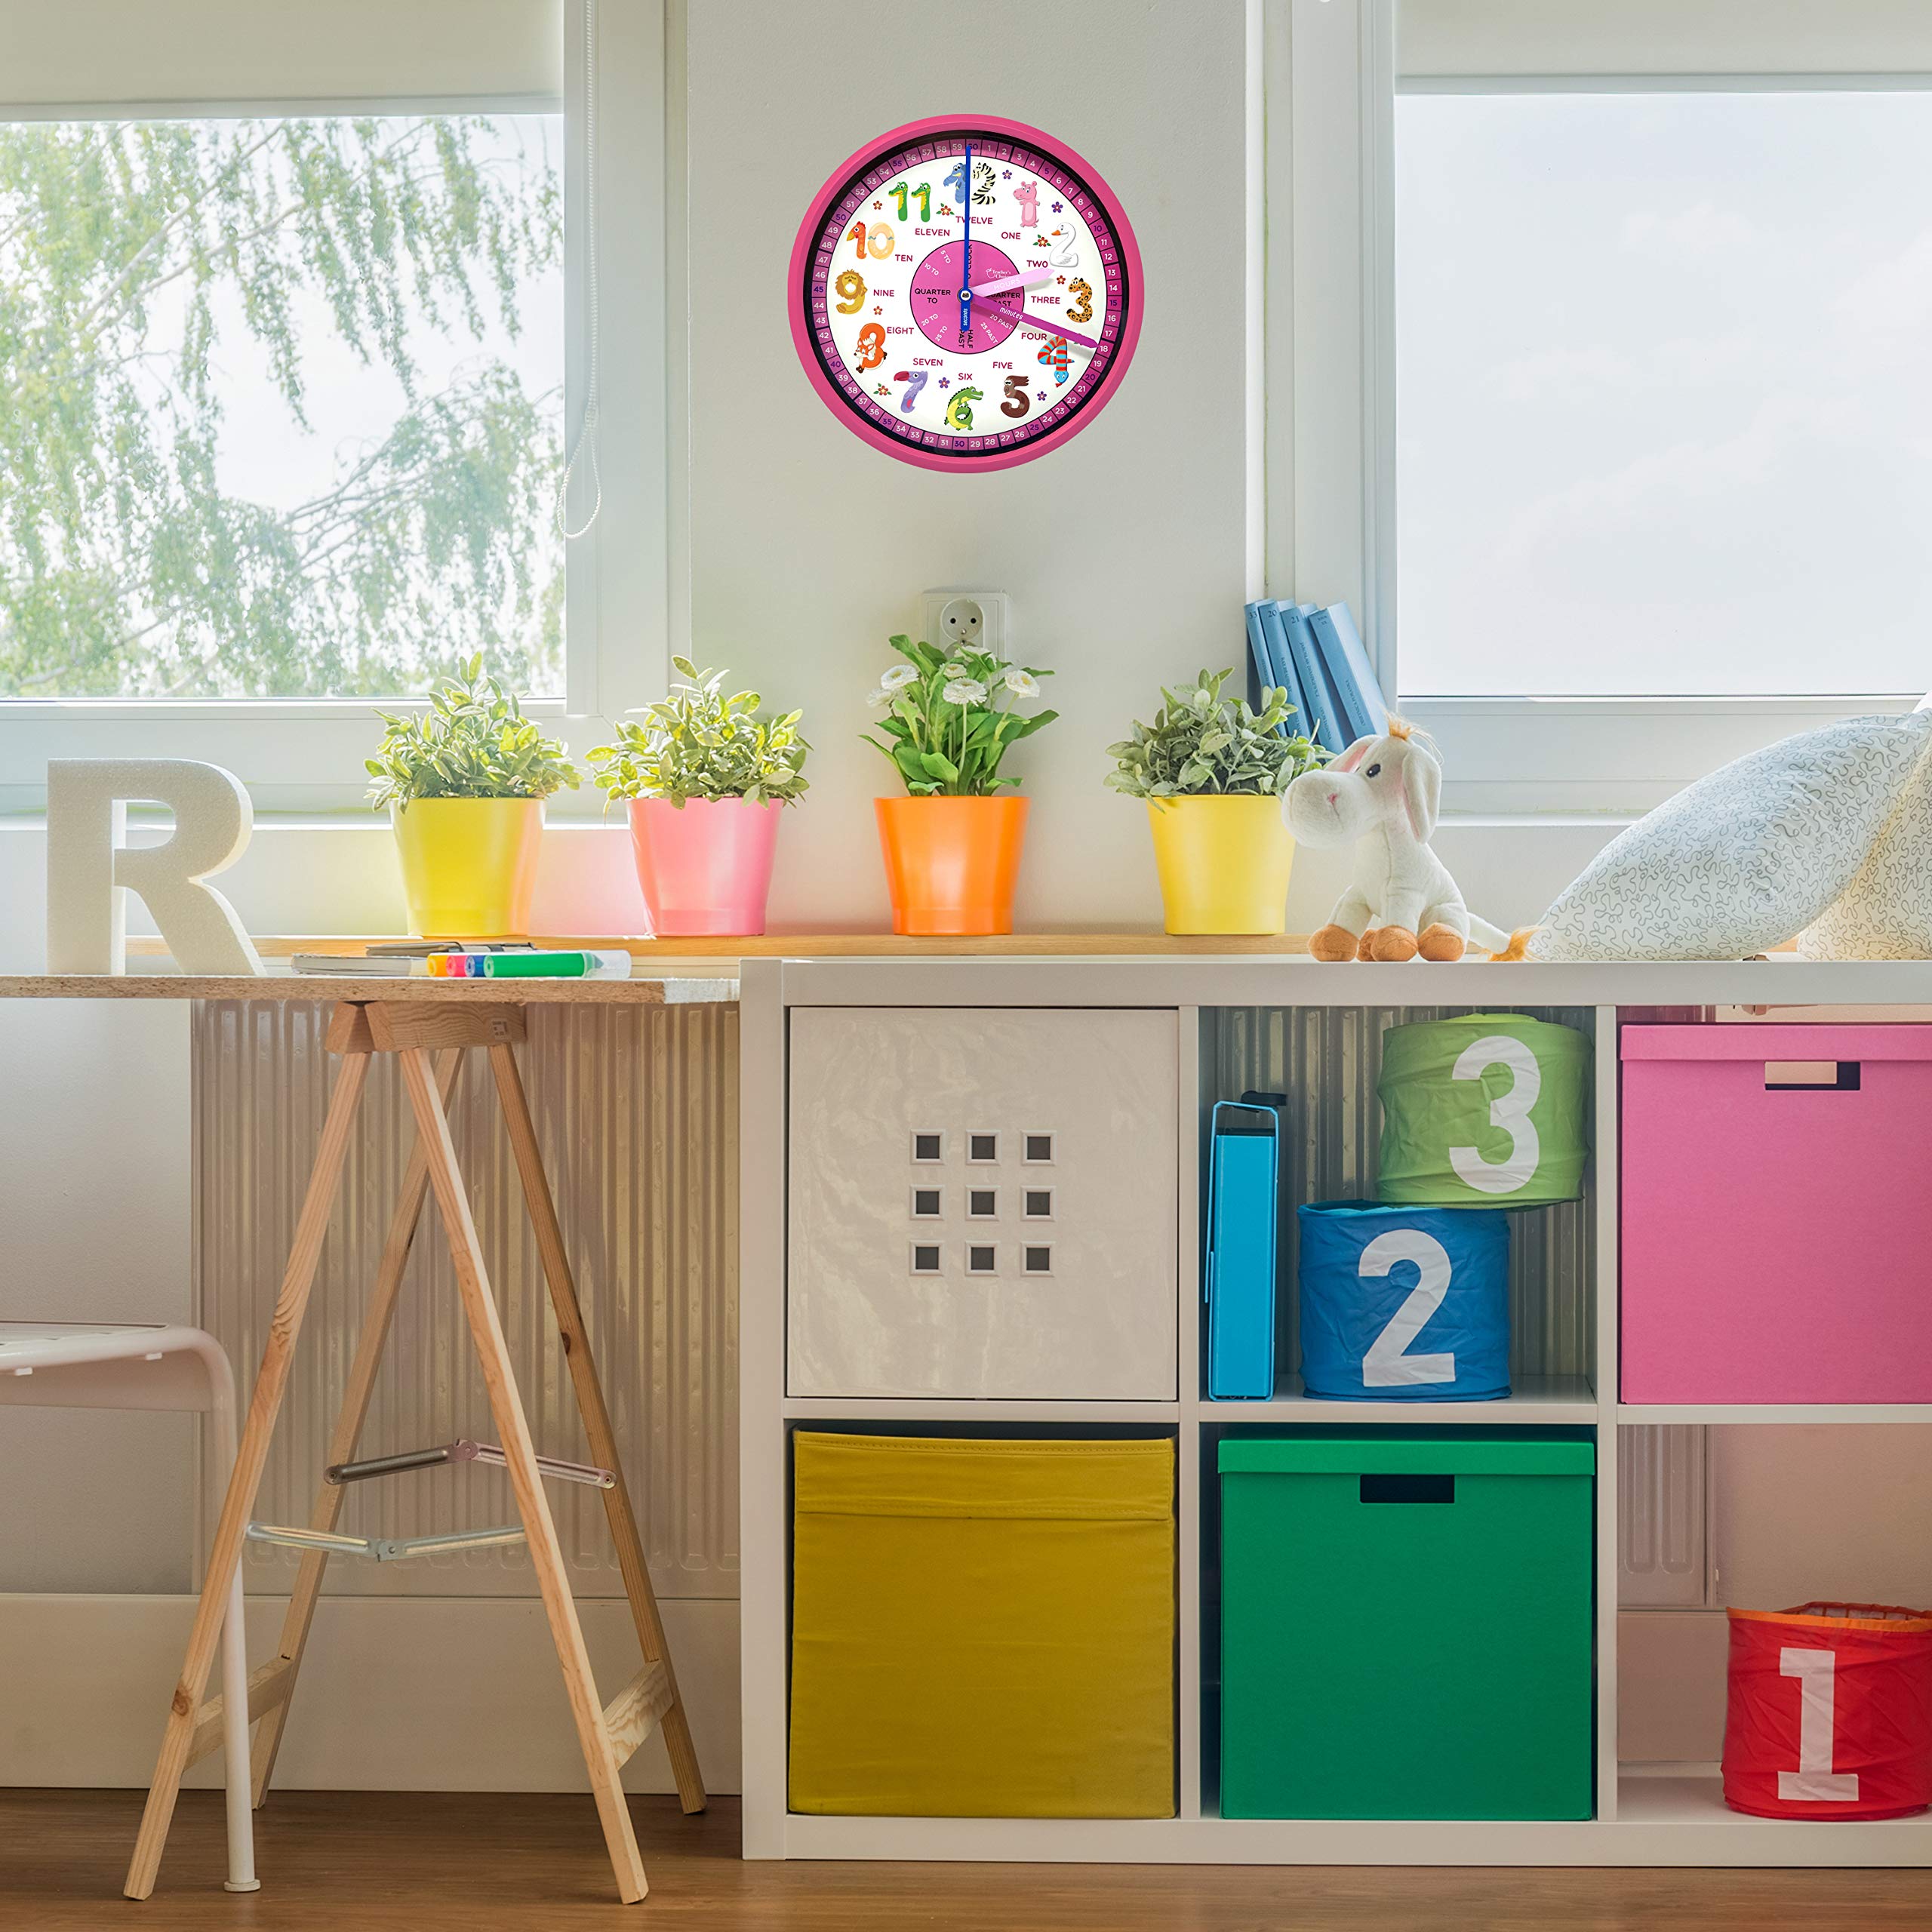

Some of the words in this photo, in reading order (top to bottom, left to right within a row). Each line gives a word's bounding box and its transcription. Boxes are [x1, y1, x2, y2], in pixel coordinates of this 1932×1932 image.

[921, 148, 931, 156] 57
[892, 159, 903, 168] 55
[943, 162, 995, 205] 12
[888, 181, 932, 223] 11
[1012, 180, 1040, 228] 1
[915, 228, 951, 236] ELEVEN
[1093, 224, 1103, 232] 10
[847, 221, 895, 260] 10
[1001, 232, 1021, 240] ONE
[1049, 222, 1078, 267] 2
[895, 254, 913, 262] TEN
[944, 254, 952, 264] TO
[1026, 260, 1048, 268] TWO
[993, 278, 1021, 291] HOURS
[834, 269, 867, 315] 9
[873, 289, 895, 297] NINE
[1031, 296, 1060, 304] THREE
[1066, 277, 1093, 323] 3
[999, 307, 1023, 320] minutes
[887, 326, 914, 334] EIGHT
[998, 318, 1014, 331] PAST
[935, 333, 942, 342] 25
[940, 325, 948, 335] TO
[980, 321, 988, 331] 25
[986, 329, 998, 344] PAST
[1021, 332, 1047, 340] FOUR
[854, 322, 888, 374] 8
[912, 358, 943, 367] SEVEN
[992, 361, 1013, 370] FIVE
[1037, 336, 1075, 387] 4
[958, 373, 973, 381] SIX
[1084, 373, 1097, 381] 20
[893, 370, 928, 414] 7
[1000, 375, 1030, 419] 5
[1066, 396, 1077, 405] 22
[944, 386, 983, 431] 6
[1249, 610, 1257, 619] 33
[1268, 608, 1277, 618] 20
[1291, 615, 1300, 624] 21
[47, 758, 266, 976] R
[1449, 1035, 1541, 1193] 3
[1358, 1229, 1456, 1386] 2
[1777, 1646, 1859, 1801] 1
